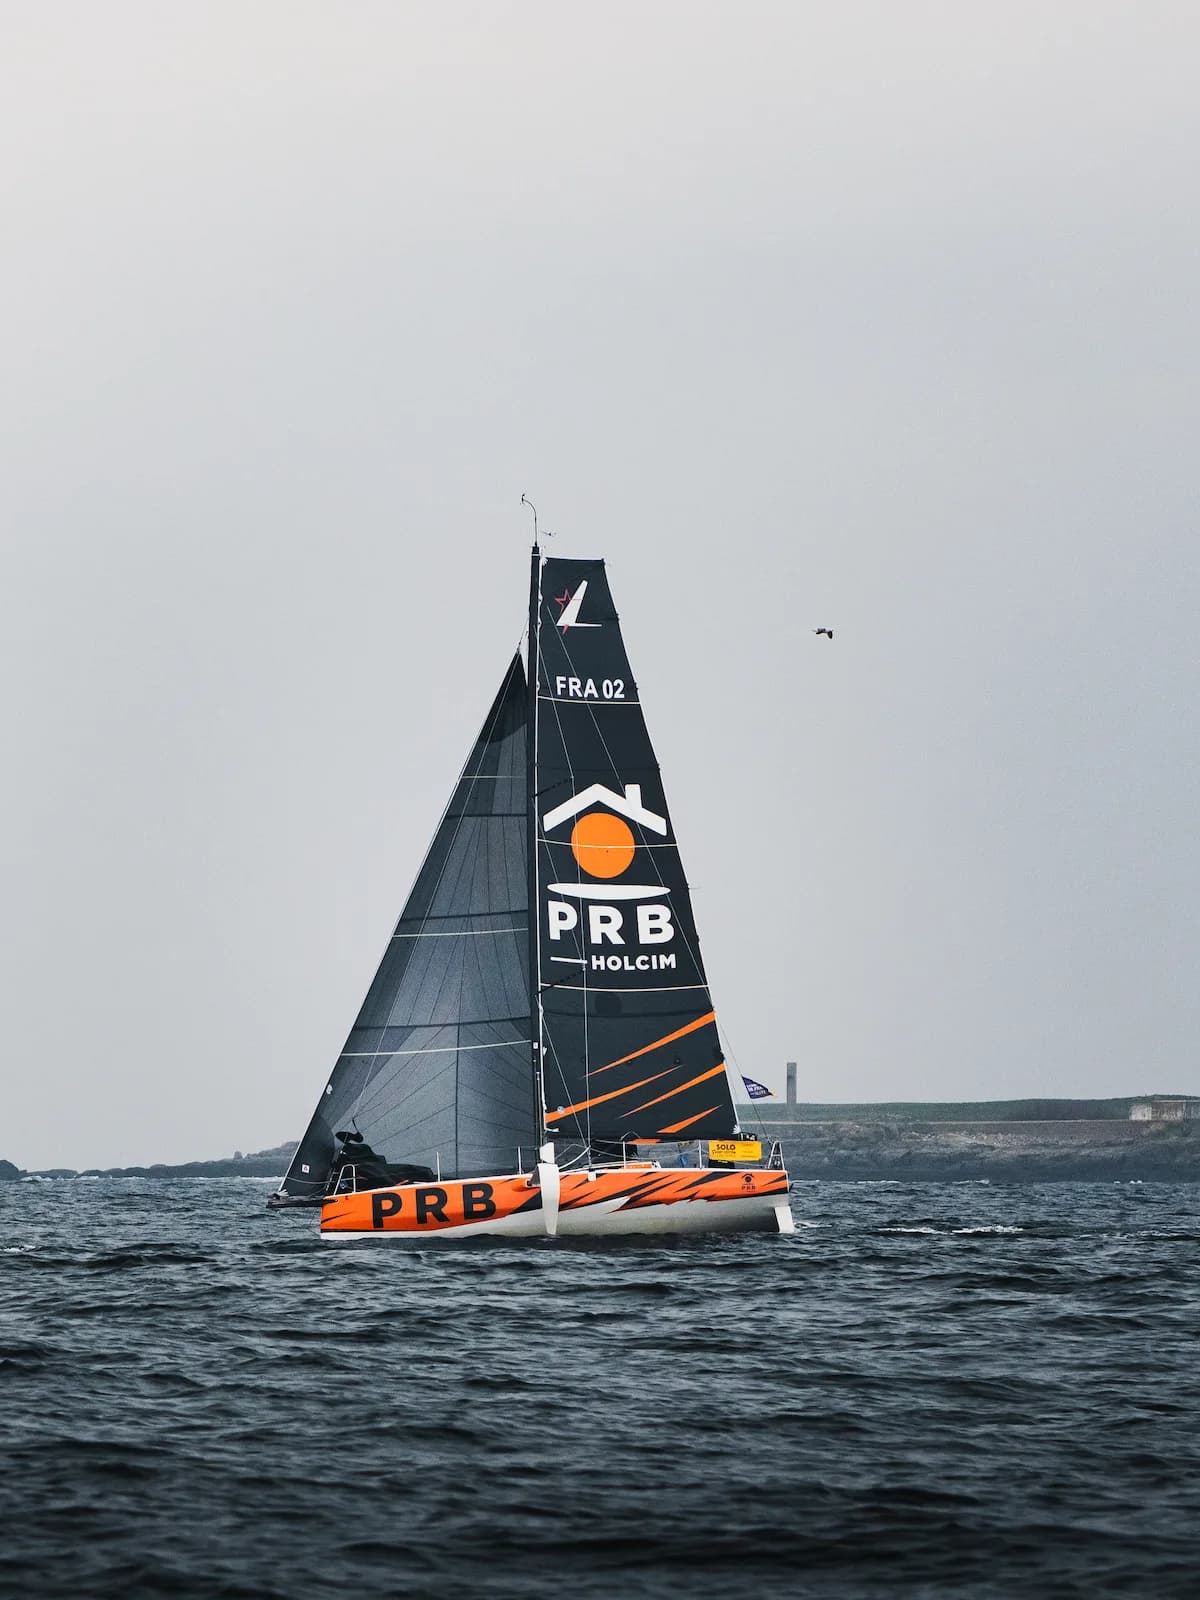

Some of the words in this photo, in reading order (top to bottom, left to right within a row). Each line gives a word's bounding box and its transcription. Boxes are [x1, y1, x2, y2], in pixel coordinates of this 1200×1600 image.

[556, 675, 599, 699] FRA
[602, 678, 625, 699] 02
[547, 900, 675, 945] PRB
[591, 953, 677, 971] HOLCIM
[371, 1182, 497, 1229] PRB
